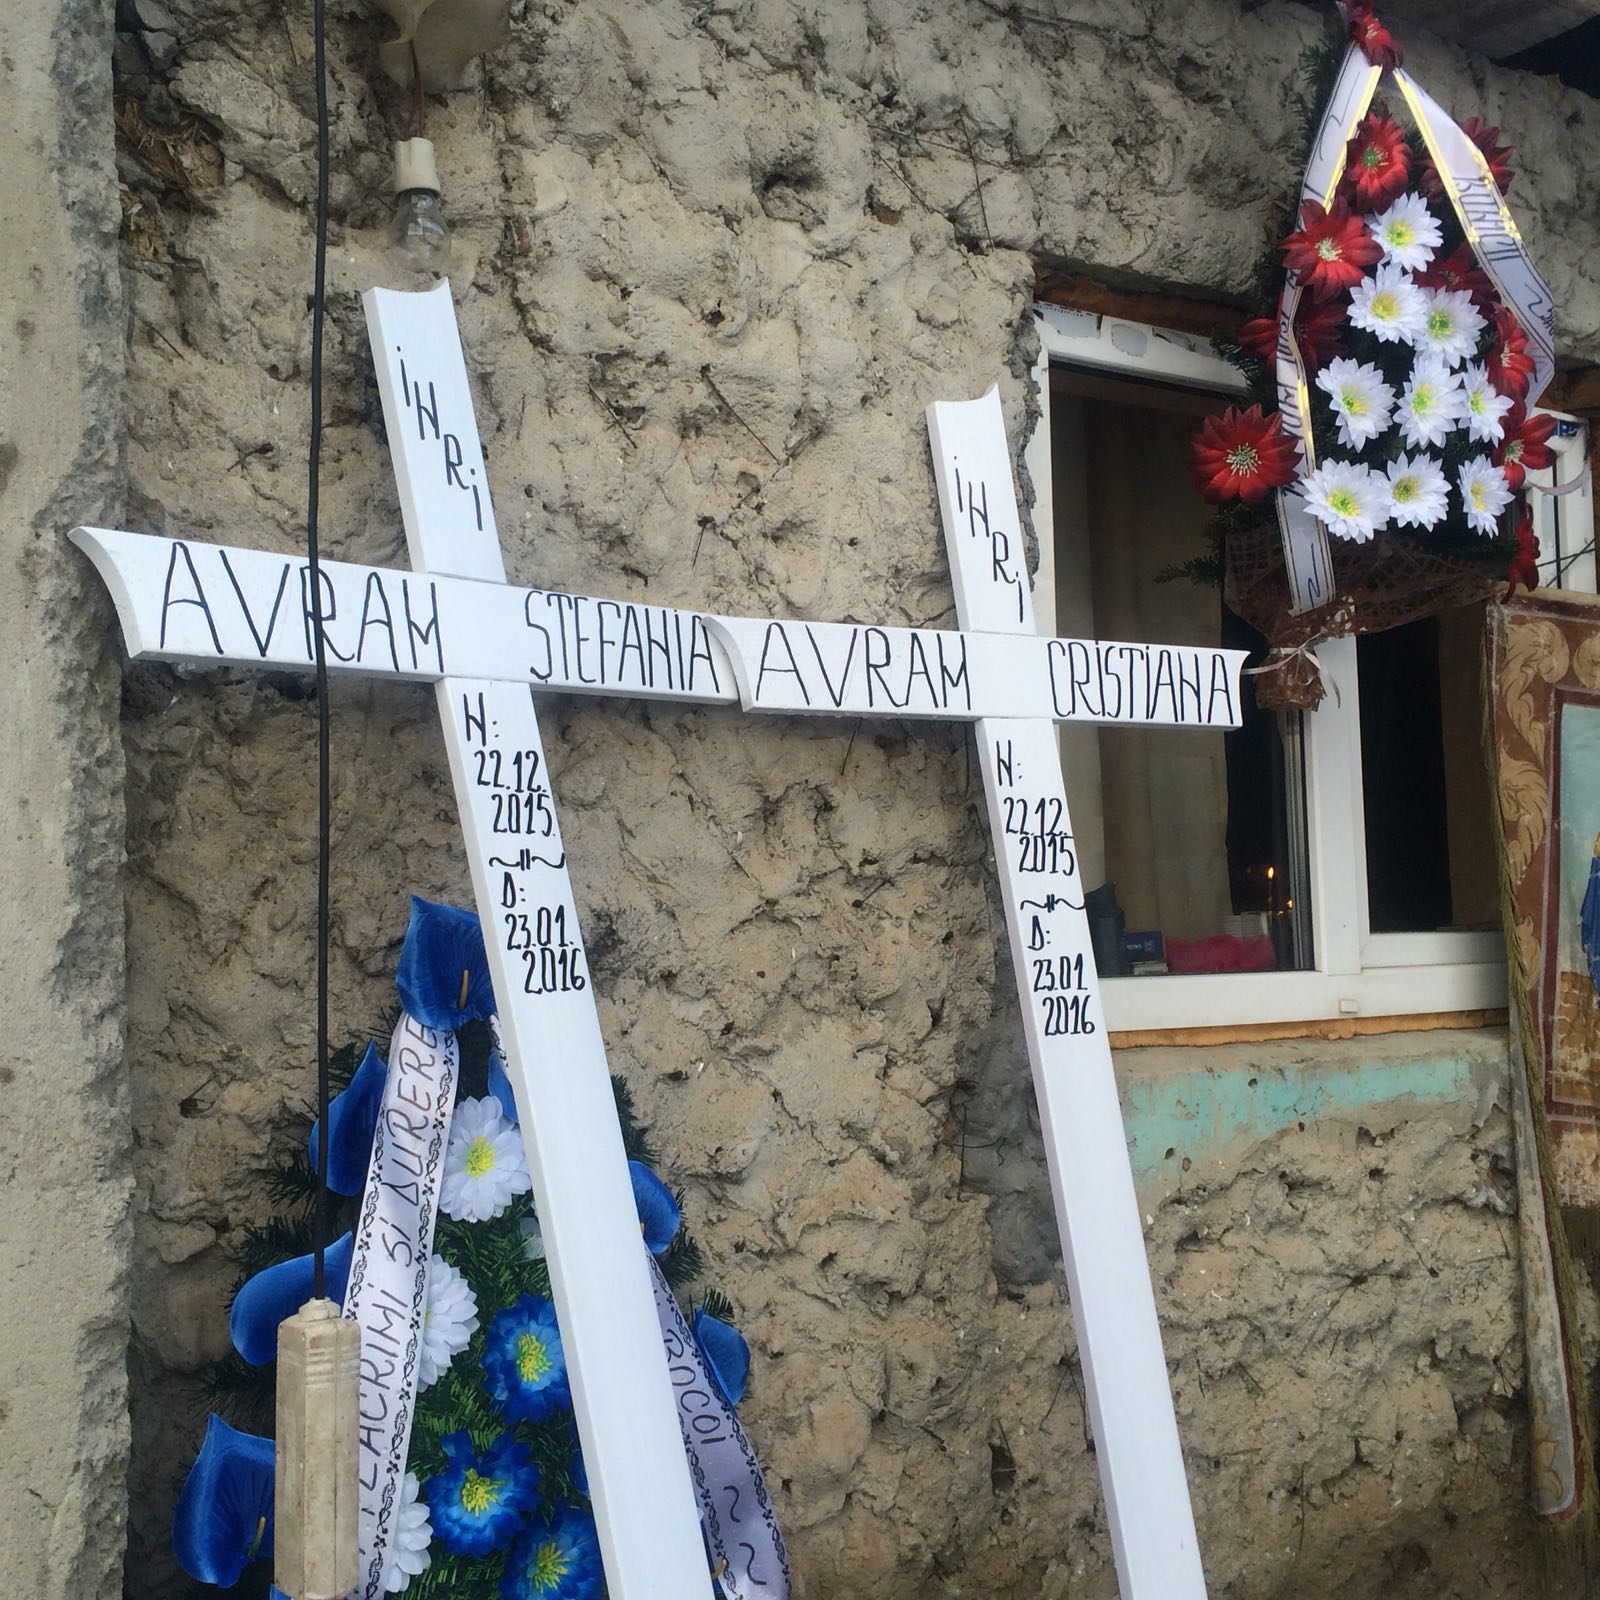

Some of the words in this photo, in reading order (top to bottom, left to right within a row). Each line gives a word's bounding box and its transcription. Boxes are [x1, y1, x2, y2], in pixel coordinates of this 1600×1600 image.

[396, 346, 483, 531] INRI
[953, 455, 1024, 623] INRI
[160, 541, 444, 673] AVRAM
[756, 622, 972, 711] AVRAM
[1047, 640, 1234, 725] CRISTIANA
[463, 692, 500, 747] N:
[474, 749, 547, 793] 22.12.
[996, 739, 1024, 787] N:
[1018, 834, 1075, 876] 2015
[501, 871, 526, 908] D:
[1027, 915, 1052, 951] D:
[522, 947, 586, 995] 2016
[1042, 994, 1096, 1037] 2016
[380, 1016, 439, 1207] DURERE
